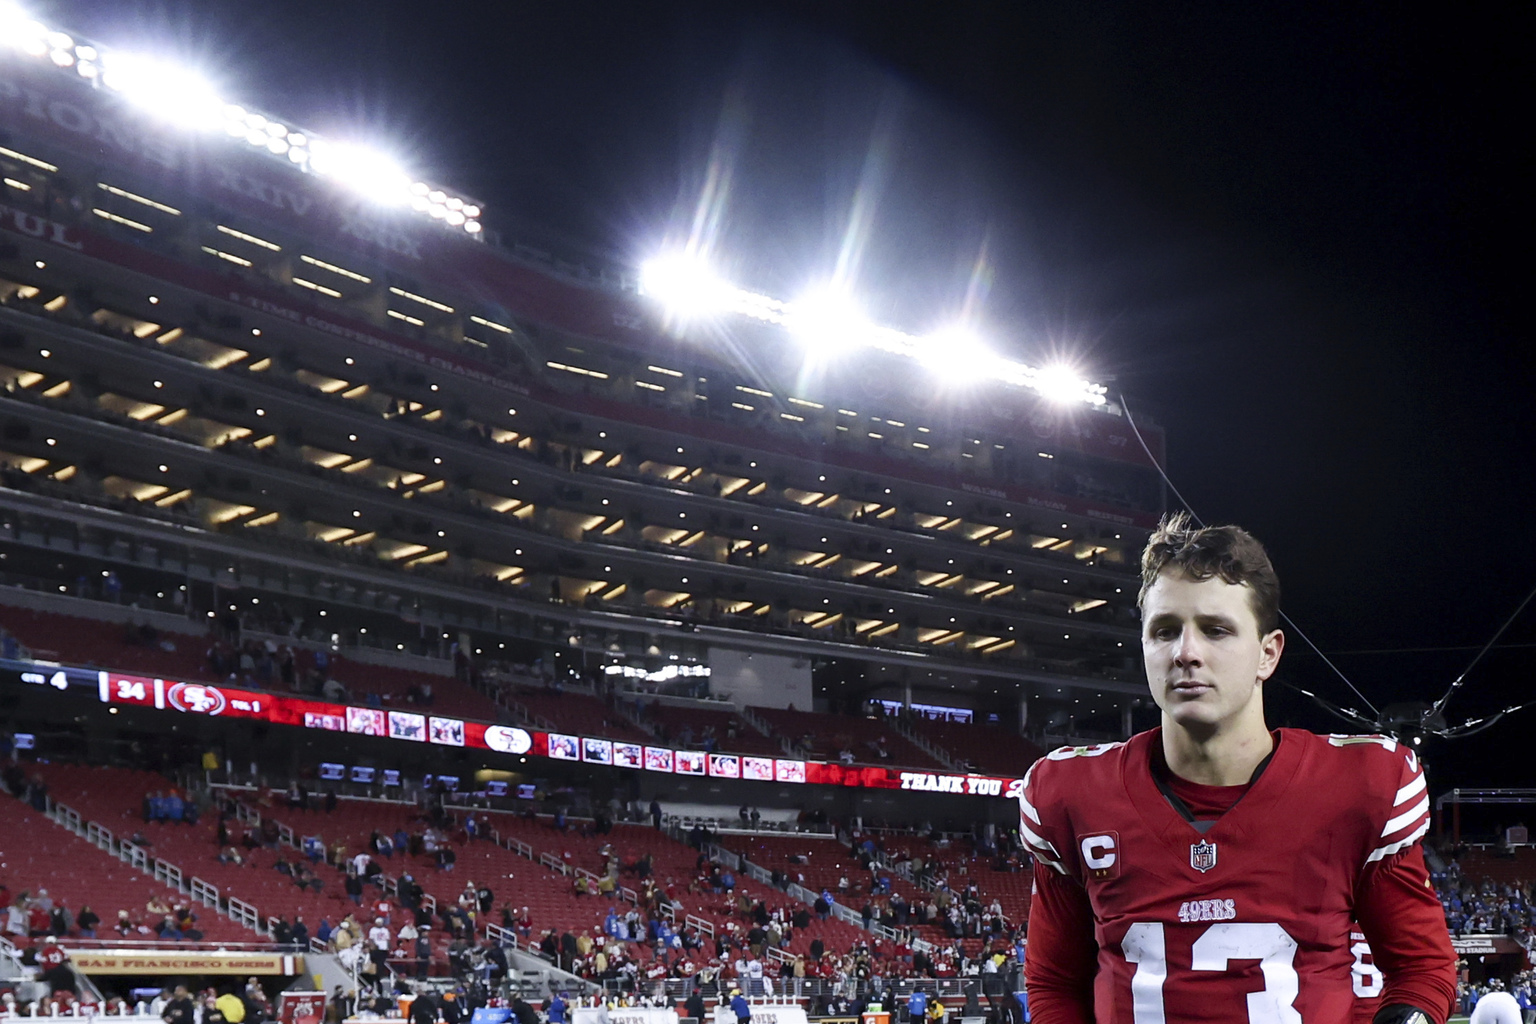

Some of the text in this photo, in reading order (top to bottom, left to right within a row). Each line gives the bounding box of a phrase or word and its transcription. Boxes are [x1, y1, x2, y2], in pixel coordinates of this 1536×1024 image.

[49, 671, 69, 691] 4
[117, 680, 146, 700] 34
[251, 701, 260, 713] 1
[900, 772, 965, 793] THANK
[966, 778, 1003, 796] YOU
[1081, 834, 1116, 870] C
[1194, 854, 1212, 867] NFL
[1178, 898, 1237, 923] 49ERS
[1466, 946, 1497, 954] STADIUM
[77, 957, 116, 968] SAN
[122, 957, 222, 969] FRANCISCO
